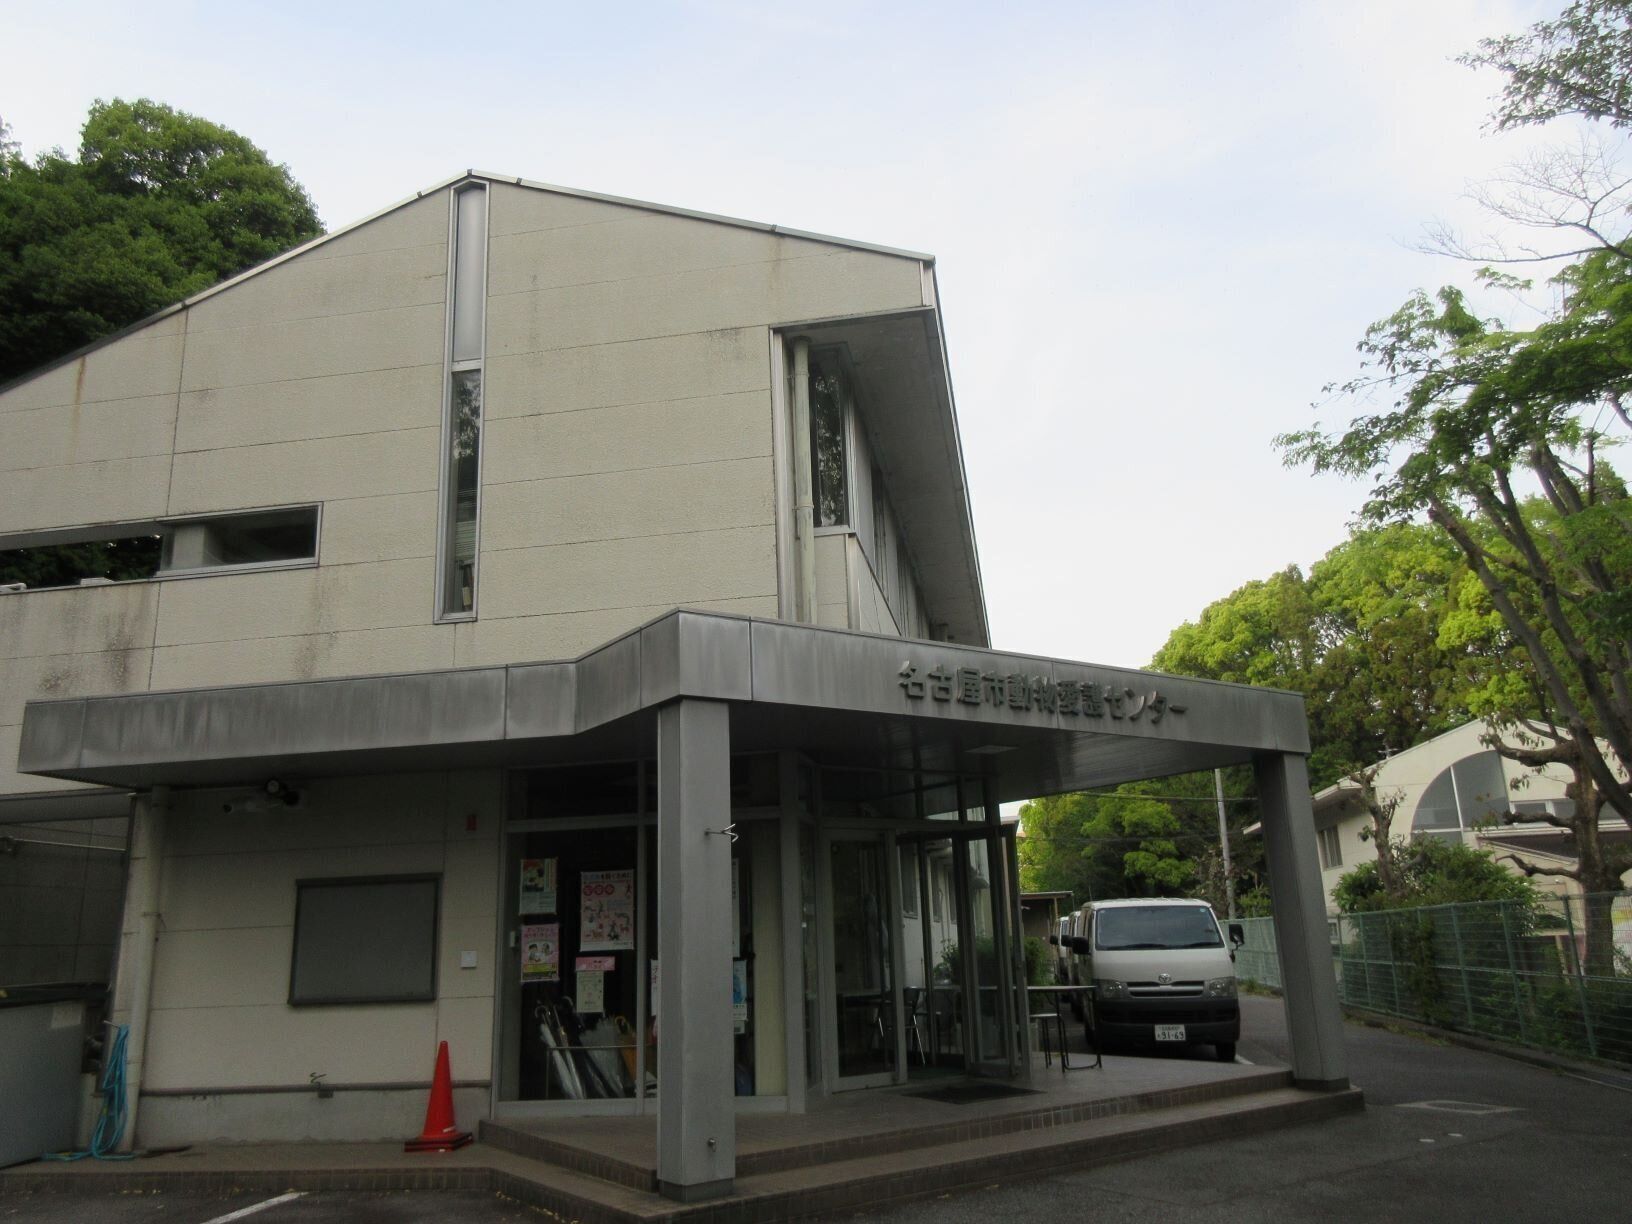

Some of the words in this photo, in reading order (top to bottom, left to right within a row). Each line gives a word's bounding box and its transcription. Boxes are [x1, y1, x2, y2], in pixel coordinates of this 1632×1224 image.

[898, 659, 1188, 724] 名古屋市動物愛護センター
